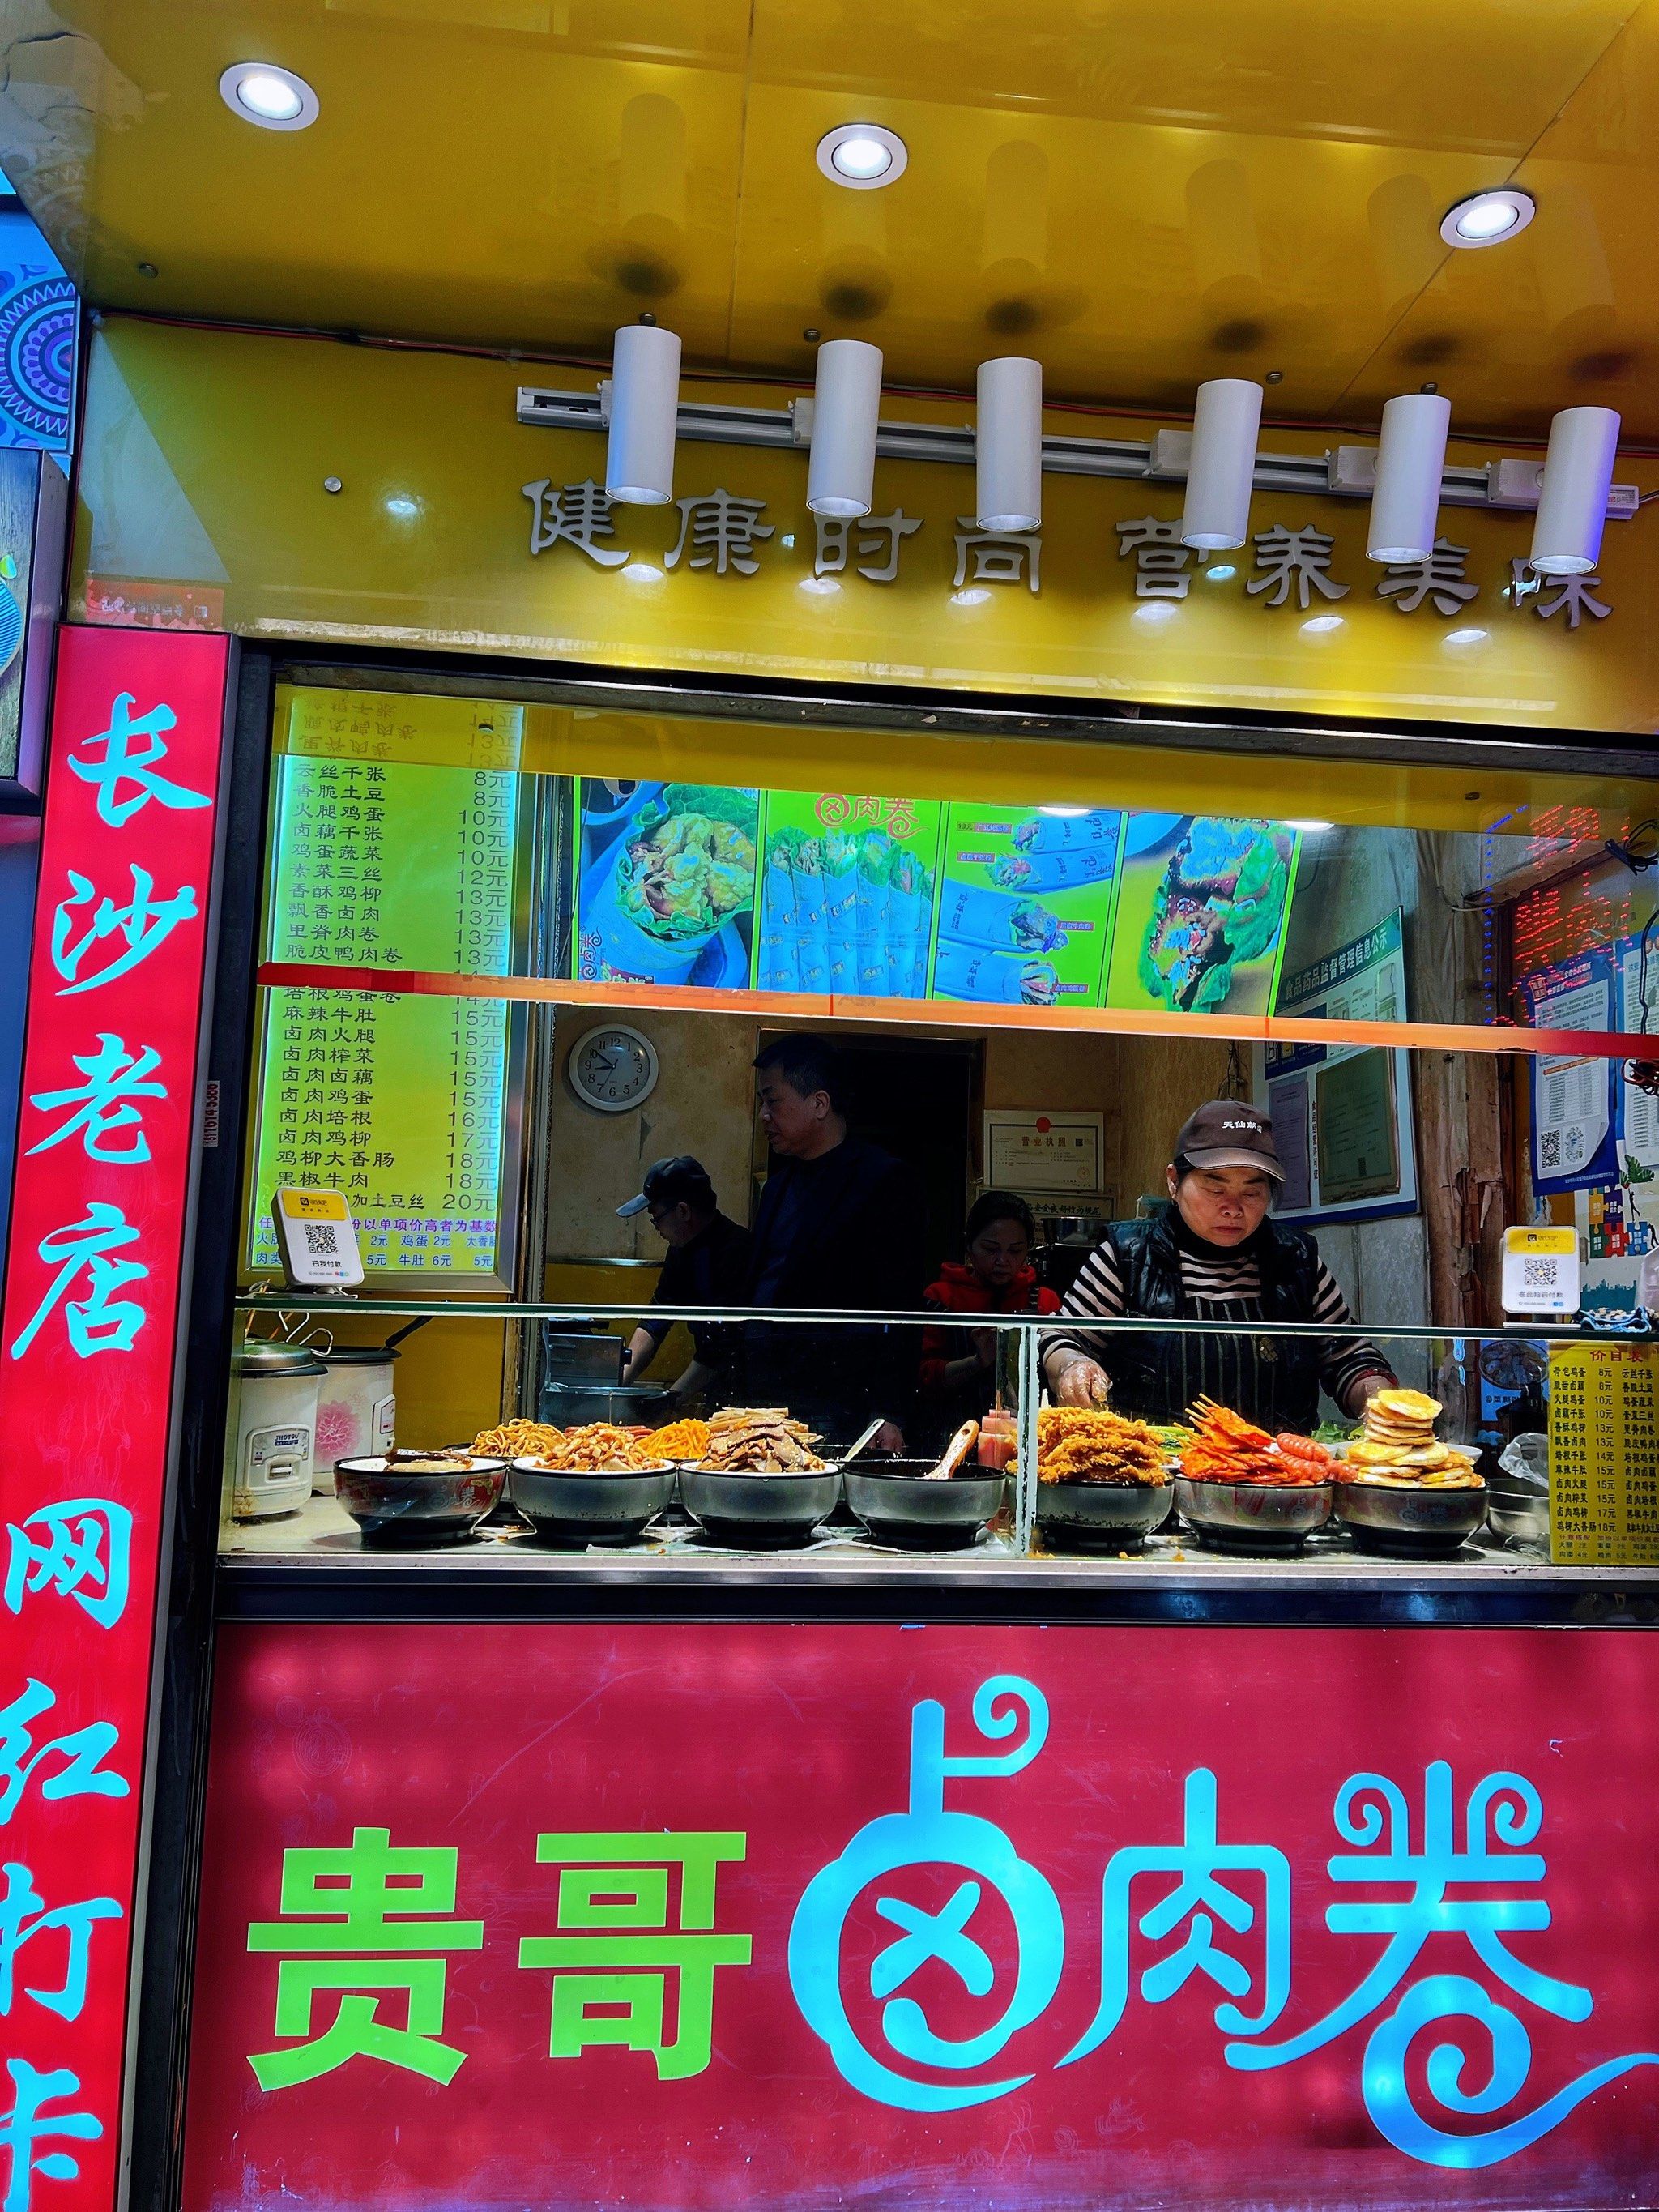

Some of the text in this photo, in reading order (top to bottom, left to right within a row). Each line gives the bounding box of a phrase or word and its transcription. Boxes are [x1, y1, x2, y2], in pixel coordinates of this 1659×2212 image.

[522, 476, 1614, 630] 健康时尚 营养美味
[297, 763, 512, 789] 云丝千张 8元
[293, 784, 510, 808] 香脆土豆 8元
[292, 803, 510, 828] 火腿鸡蛋 10元
[293, 822, 510, 848] 卤藕千张 10元
[292, 843, 509, 869] 鸡蛋蔬菜 10元
[290, 863, 508, 888] 素菜三丝 12元
[289, 882, 507, 907] 香酥鸡柳 13元
[287, 903, 507, 927] 飘香卤肉 13元
[286, 924, 506, 947] 里脊肉卷 13元
[285, 945, 505, 967] 脆皮鸭肉卷 13元
[1286, 927, 1388, 1001] 食品药品监督管理信息公示
[283, 1006, 503, 1028] 麻辣牛肚 15元
[11, 691, 213, 1360] 长沙老店
[284, 1025, 502, 1048] 卤肉火腿 15元
[610, 1037, 621, 1047] 12
[599, 1040, 606, 1050] 11
[283, 1045, 501, 1069] 卤肉榨菜 15元
[633, 1052, 641, 1061] 2
[584, 1060, 592, 1070] 9
[636, 1063, 643, 1074] 3
[282, 1066, 501, 1089] 卤肉卤藕 15元
[587, 1073, 595, 1083] 8
[632, 1076, 640, 1087] 4
[596, 1083, 604, 1093] 7
[608, 1087, 616, 1097] 6
[622, 1084, 630, 1095] 5
[281, 1087, 501, 1109] 卤肉鸡蛋 15元
[279, 1108, 500, 1129] 卤肉培根 16元
[279, 1129, 499, 1151] 卤肉鸡柳 17元
[1021, 1136, 1067, 1147] 营业执照
[275, 1150, 498, 1171] 鸡柳大香肠 18元
[275, 1172, 497, 1192] 黑椒牛肉 18元
[347, 1193, 496, 1212] 加土豆丝 20元
[370, 1235, 388, 1246] 2元
[401, 1234, 428, 1247] 鸡蛋
[433, 1236, 450, 1247] 2元
[366, 1254, 386, 1266] 5元
[399, 1254, 424, 1266] 牛肚
[432, 1256, 452, 1266] 6元
[474, 1256, 493, 1267] 5元
[1589, 1350, 1644, 1363] 价目表
[1598, 1368, 1613, 1377] 8元
[1599, 1381, 1613, 1391] 8元
[1595, 1395, 1614, 1405] 10元
[1595, 1409, 1614, 1419] 10元
[1595, 1424, 1614, 1433] 13元
[1596, 1437, 1614, 1447] 13元
[1596, 1451, 1615, 1462] 14元
[1597, 1465, 1615, 1475] 15元
[1597, 1480, 1616, 1490] 15元
[1597, 1493, 1616, 1504] 15元
[1597, 1508, 1617, 1518] 17元
[1597, 1522, 1617, 1532] 18元
[0, 1497, 134, 2212] 网红打卡
[245, 1672, 1659, 2169] 贵哥卤肉卷
